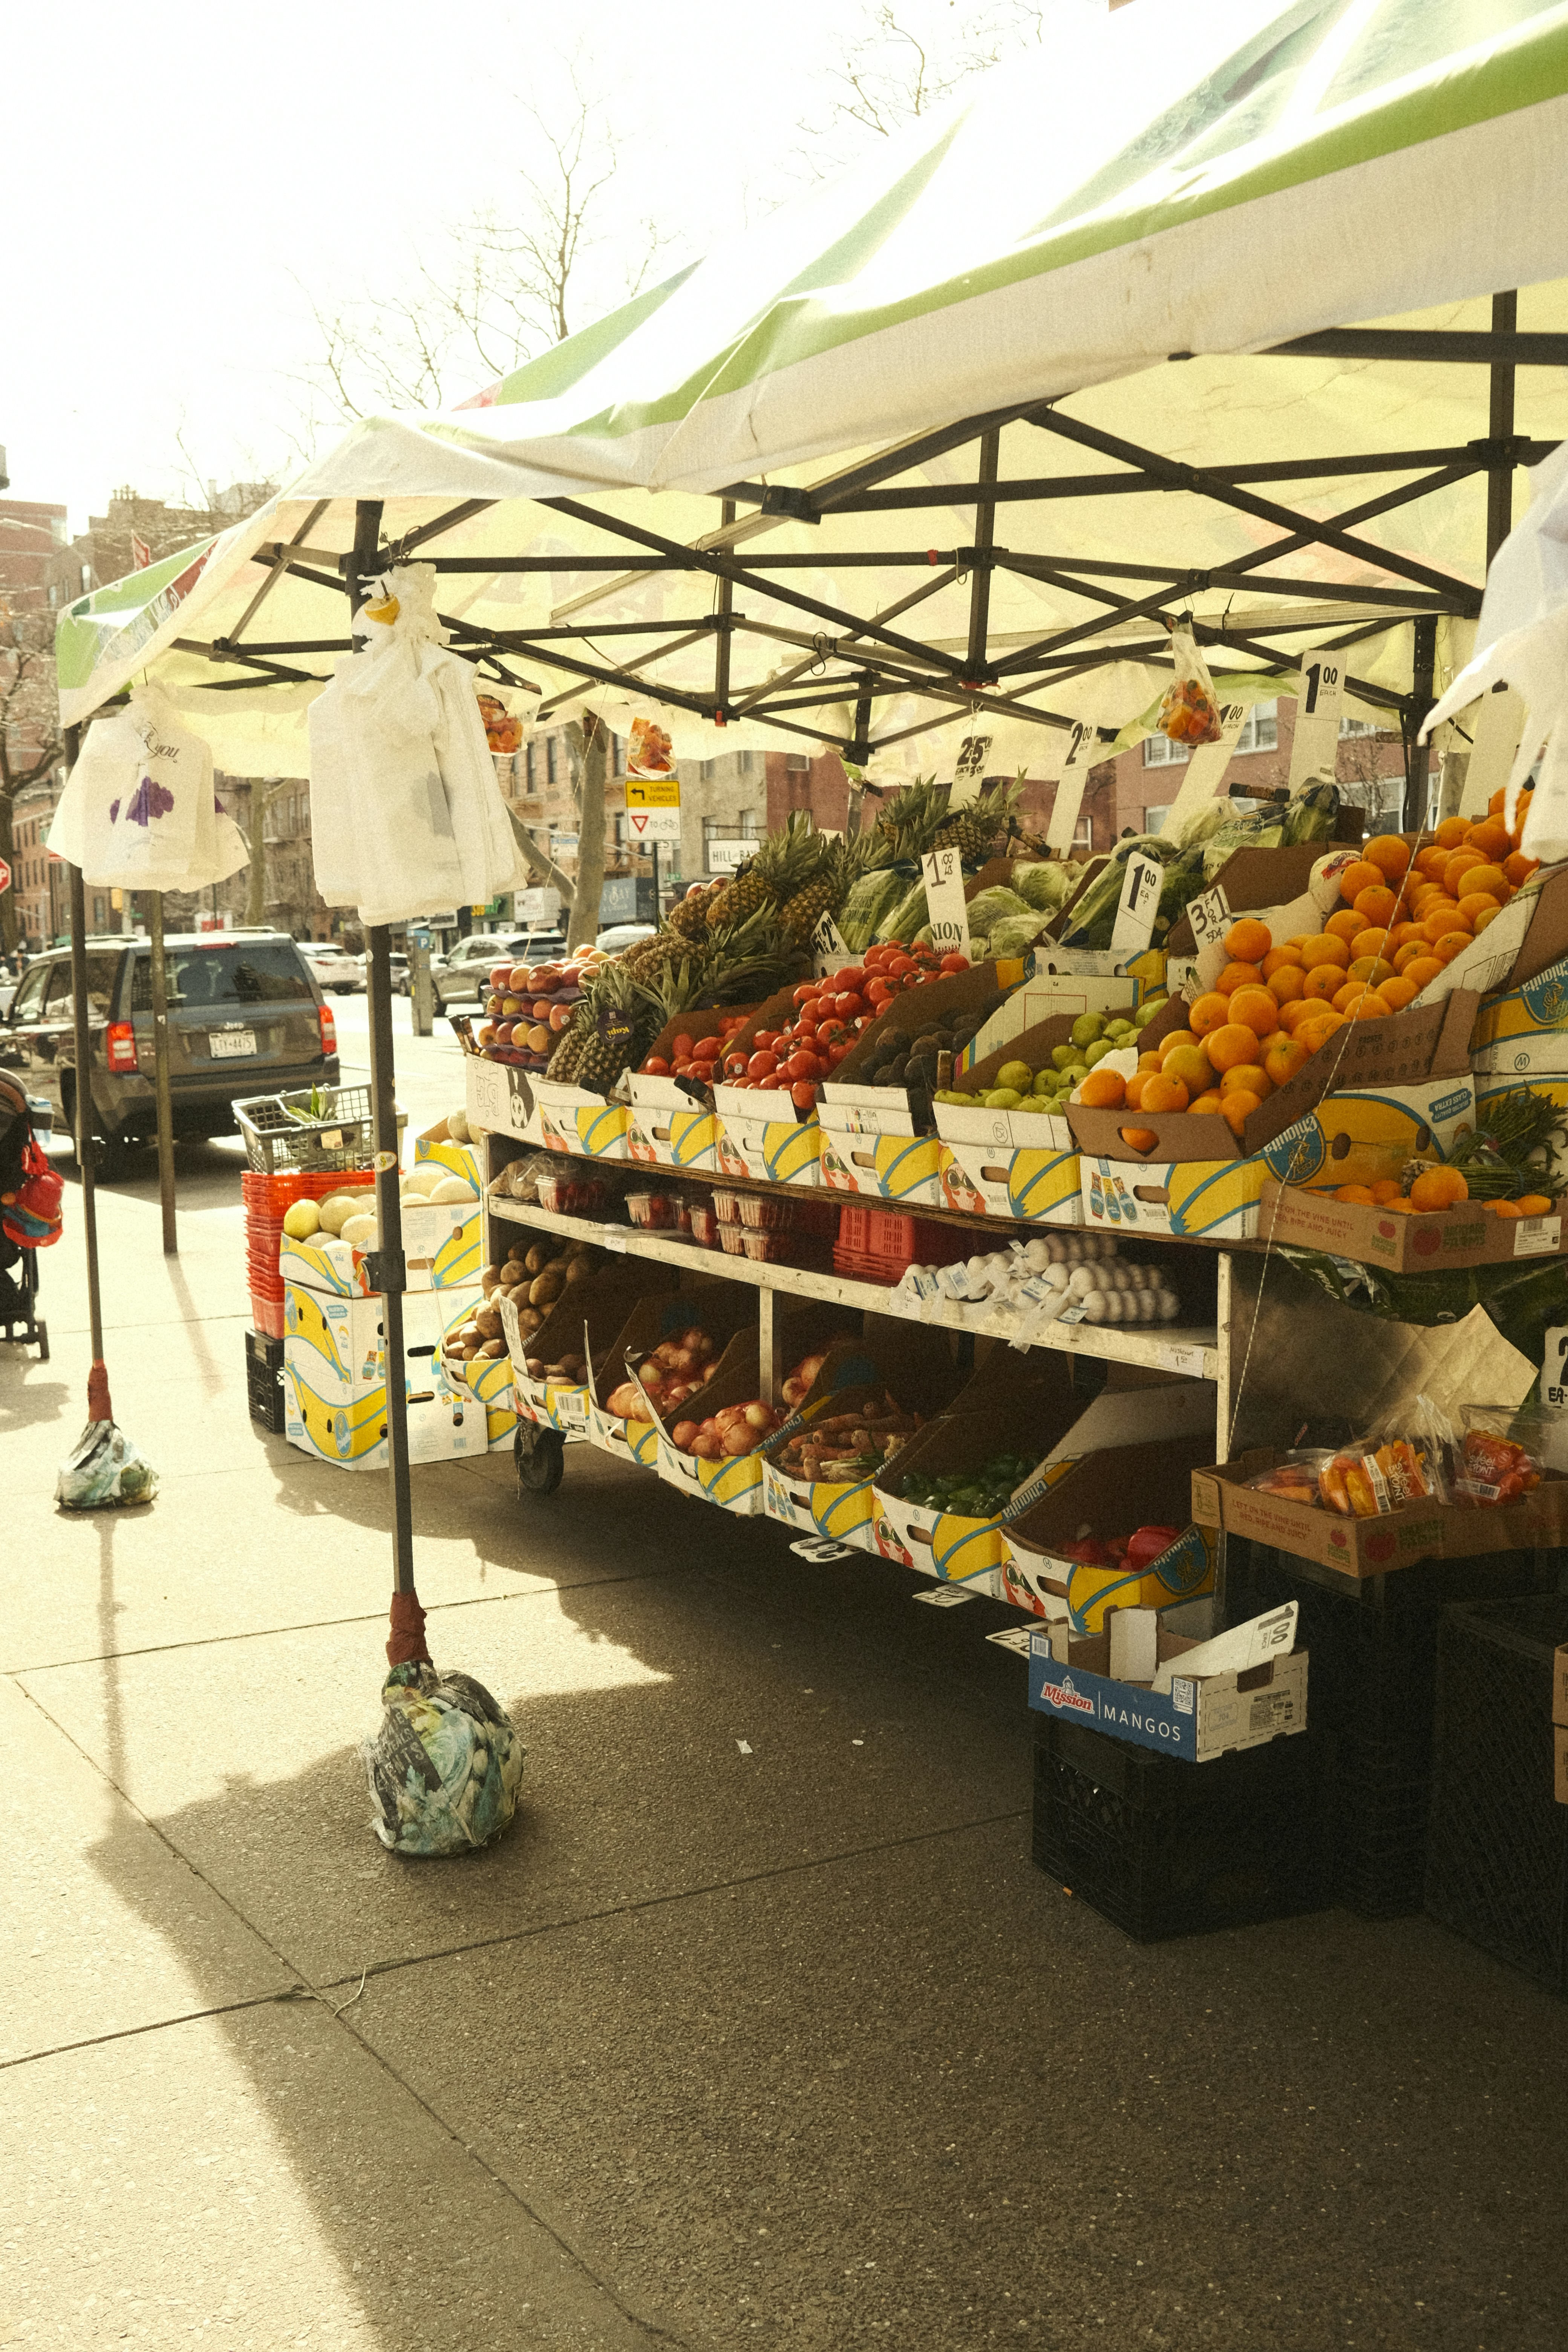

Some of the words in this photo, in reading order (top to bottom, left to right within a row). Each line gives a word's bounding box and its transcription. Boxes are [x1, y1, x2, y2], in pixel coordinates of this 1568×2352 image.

[1306, 663, 1321, 713] 1
[1323, 666, 1338, 685] 00
[1229, 706, 1243, 720] 00
[957, 736, 973, 766] 2
[971, 736, 988, 765] 5
[1065, 722, 1084, 766] 2
[1083, 726, 1092, 741] 00
[713, 850, 732, 862] HILL
[927, 853, 946, 888] 1
[1127, 863, 1145, 912] 1
[1145, 870, 1156, 887] 00
[1140, 890, 1149, 900] EA
[1191, 904, 1208, 936] 3
[1211, 887, 1228, 922] 1
[821, 921, 838, 952] 2
[224, 1021, 244, 1030] Jeep
[1435, 1098, 1452, 1112] EXTRA
[1453, 1091, 1467, 1104] CLASS
[1263, 1115, 1318, 1153] Chiquita
[1268, 1201, 1285, 1211] LET
[1285, 1206, 1295, 1215] ON
[1298, 1209, 1310, 1219] THE
[1312, 1213, 1330, 1224] VINE
[1332, 1218, 1354, 1231] UNTIL
[1290, 1217, 1306, 1228] RIPE
[1308, 1223, 1323, 1233] AND
[1325, 1227, 1347, 1239] JUICY
[1470, 1449, 1496, 1467] sweet
[1395, 1462, 1414, 1499] sweet
[1002, 1479, 1047, 1519] Chiquita
[1232, 1500, 1247, 1510] LEFT
[1249, 1506, 1258, 1514] ON
[1260, 1509, 1272, 1520] THE
[1274, 1513, 1289, 1524] VINE
[1291, 1519, 1311, 1532] UNTIL
[1239, 1512, 1254, 1523] RED,
[1256, 1517, 1269, 1528] RIPE
[1271, 1524, 1285, 1533] AND
[1287, 1528, 1307, 1540] JUICY
[1257, 1605, 1294, 1630] 1
[1270, 1622, 1290, 1645] 00
[1043, 1685, 1092, 1711] Mission
[1104, 1704, 1181, 1741] MANGOS
